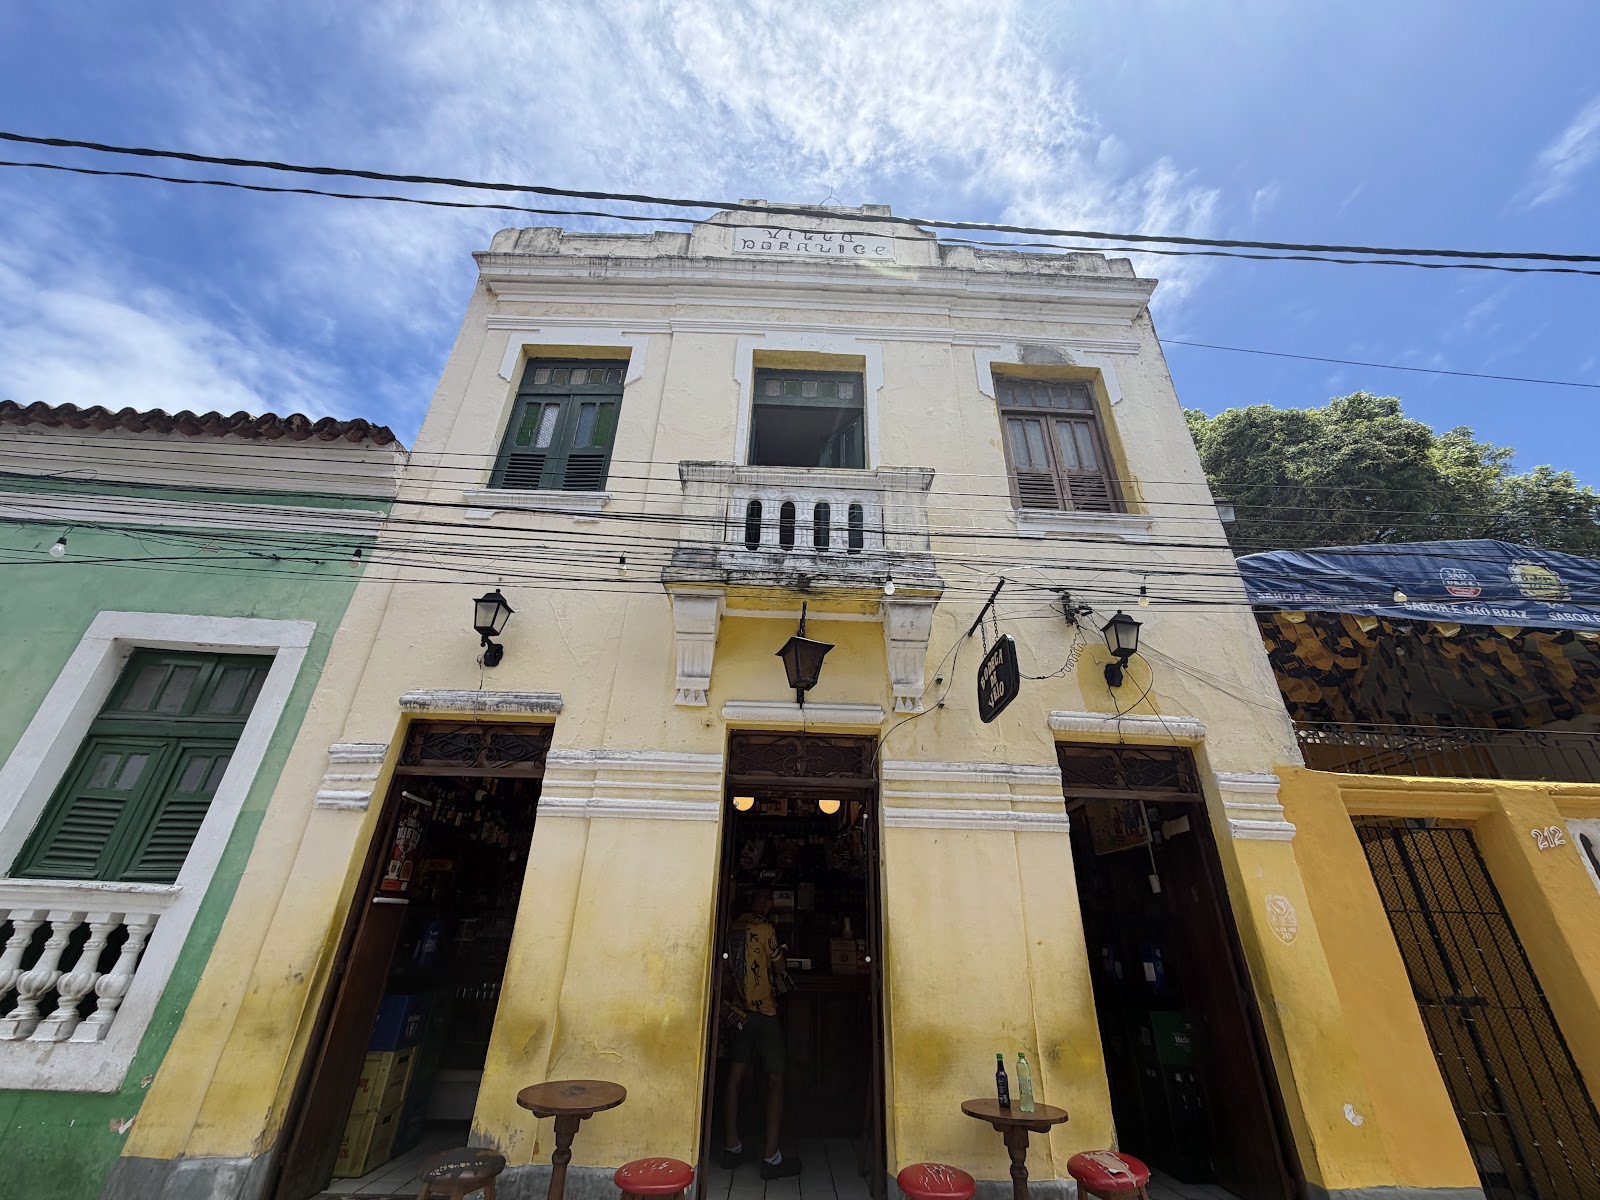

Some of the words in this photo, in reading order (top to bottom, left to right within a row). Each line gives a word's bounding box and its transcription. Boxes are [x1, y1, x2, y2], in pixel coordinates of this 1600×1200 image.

[1404, 602, 1450, 613] SABOR
[1491, 608, 1531, 619] BRAZ
[1548, 612, 1595, 622] SABOR
[980, 649, 1003, 690] BODEGA
[1530, 825, 1566, 852] 212
